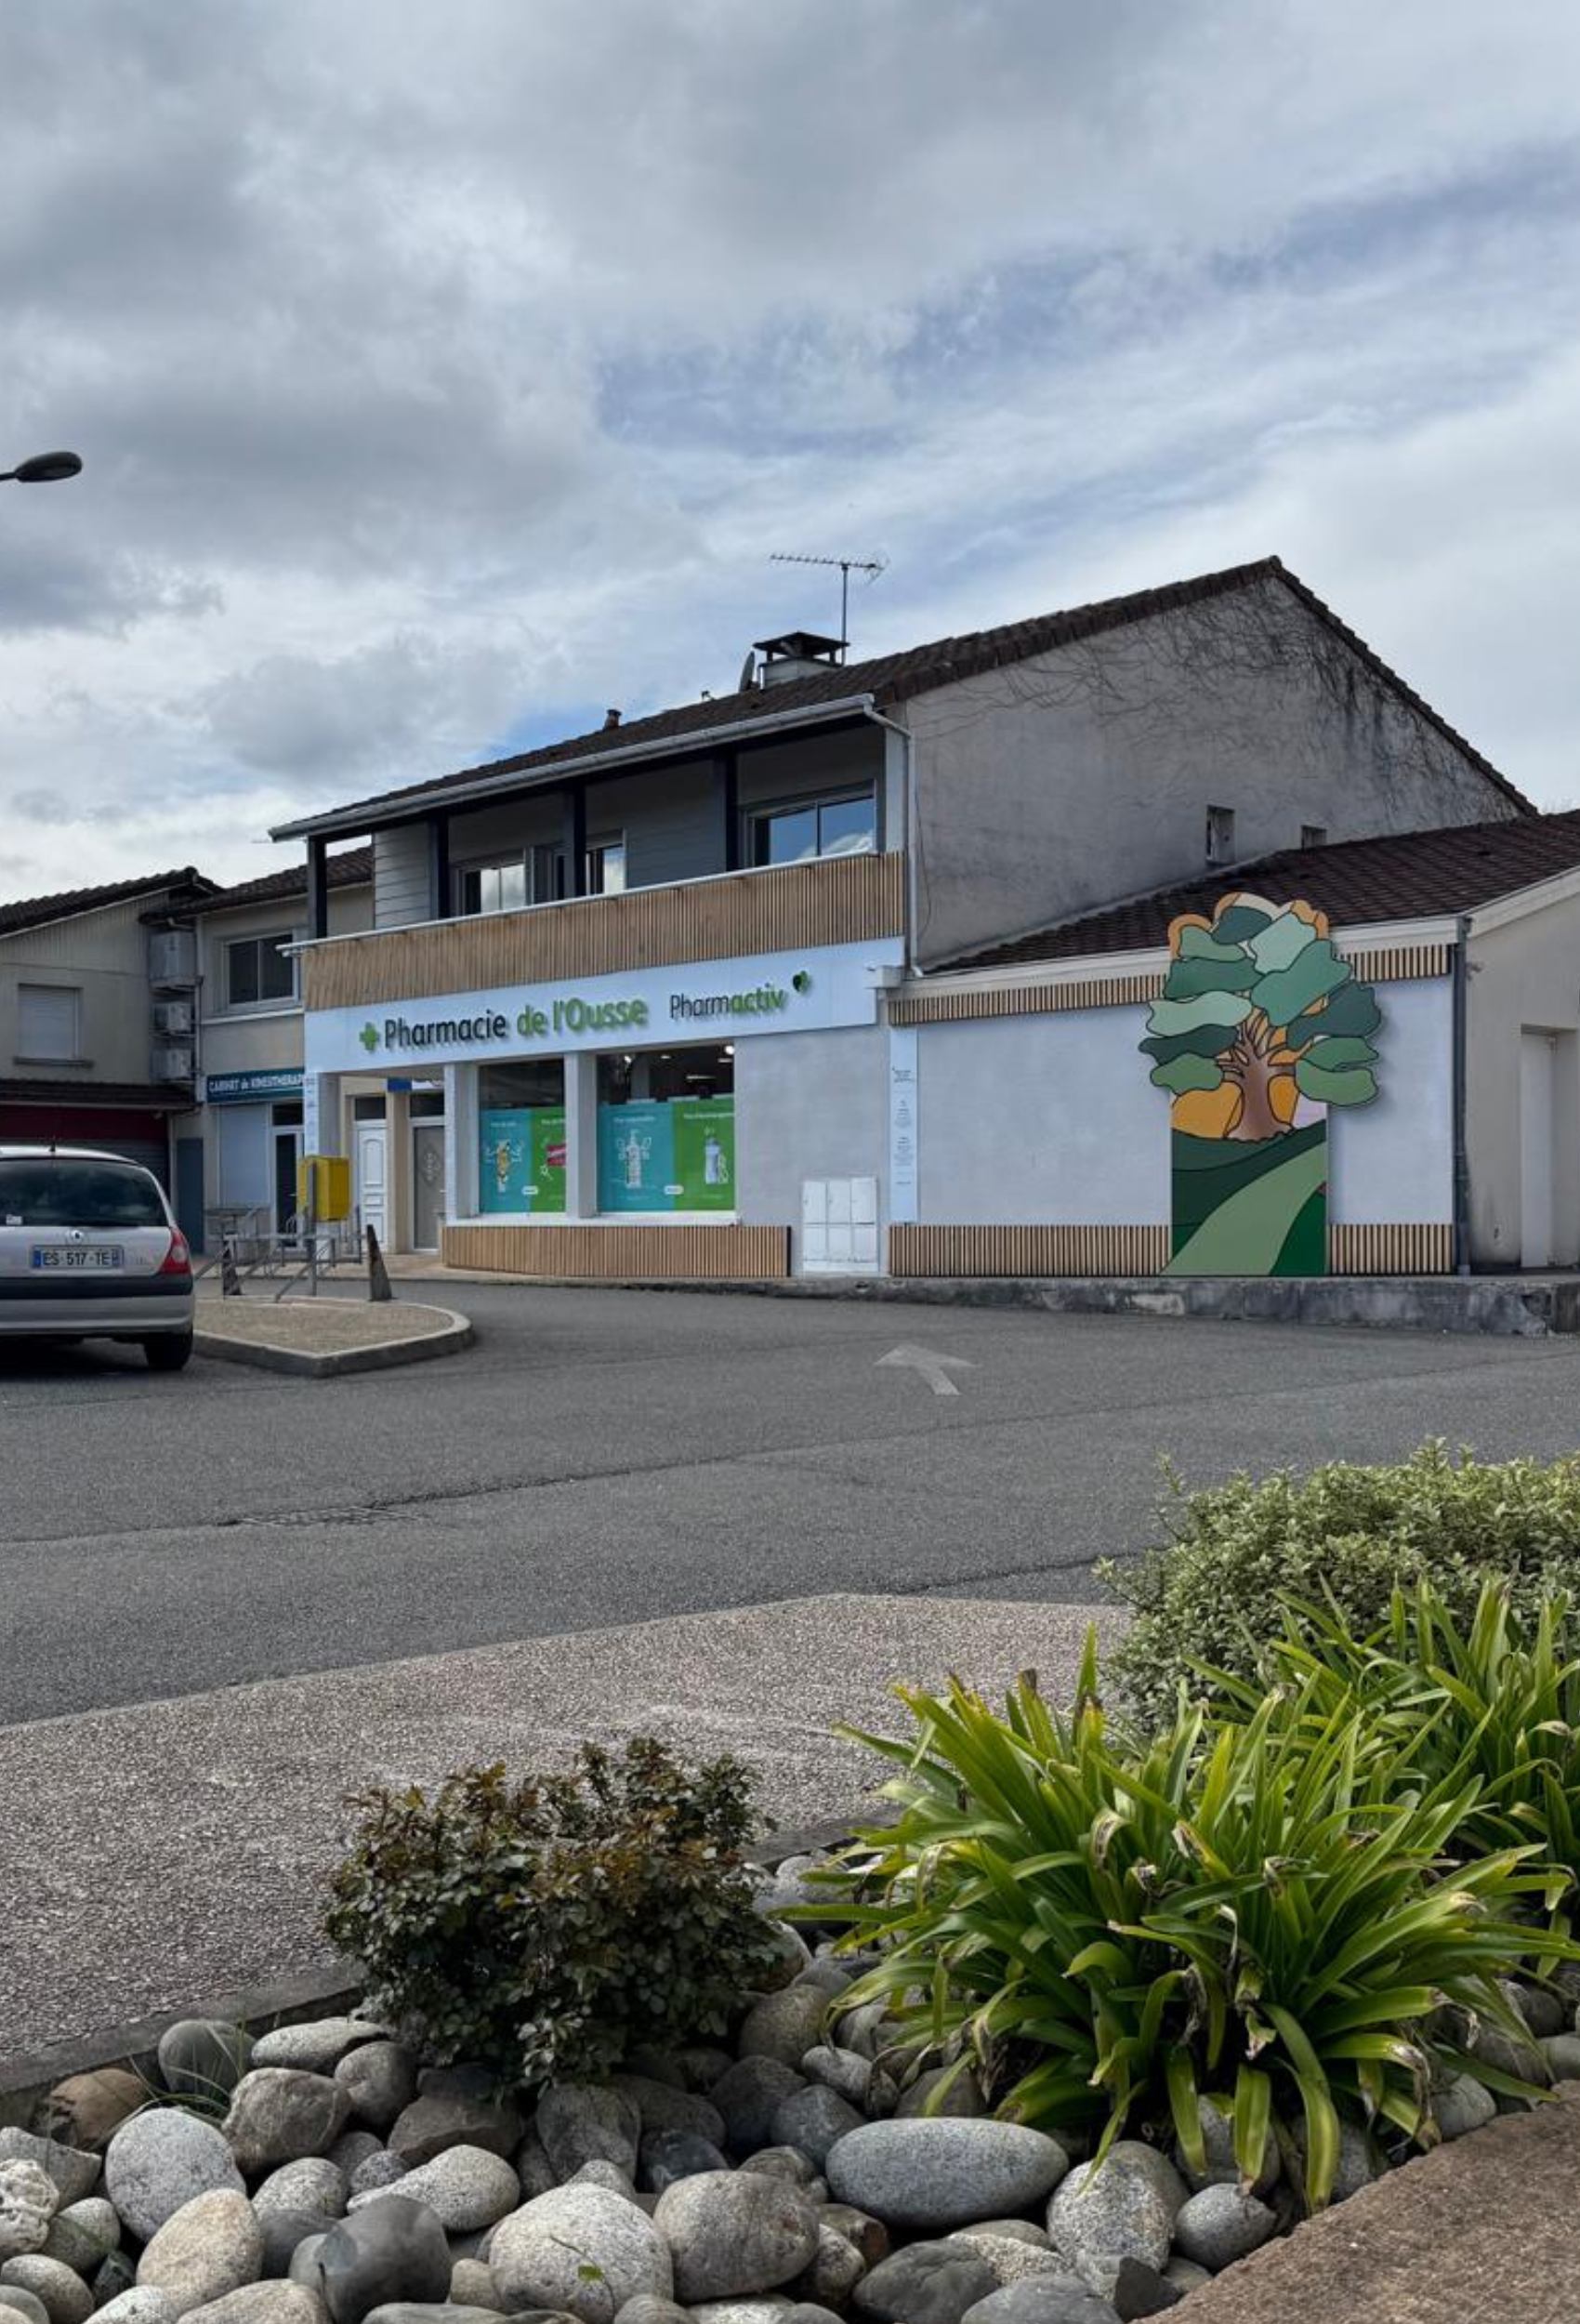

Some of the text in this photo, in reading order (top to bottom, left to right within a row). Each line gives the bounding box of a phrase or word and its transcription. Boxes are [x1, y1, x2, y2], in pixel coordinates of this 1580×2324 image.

[384, 996, 649, 1050] Pharmacie de l'Ousse
[670, 982, 784, 1019] Pharmactiv
